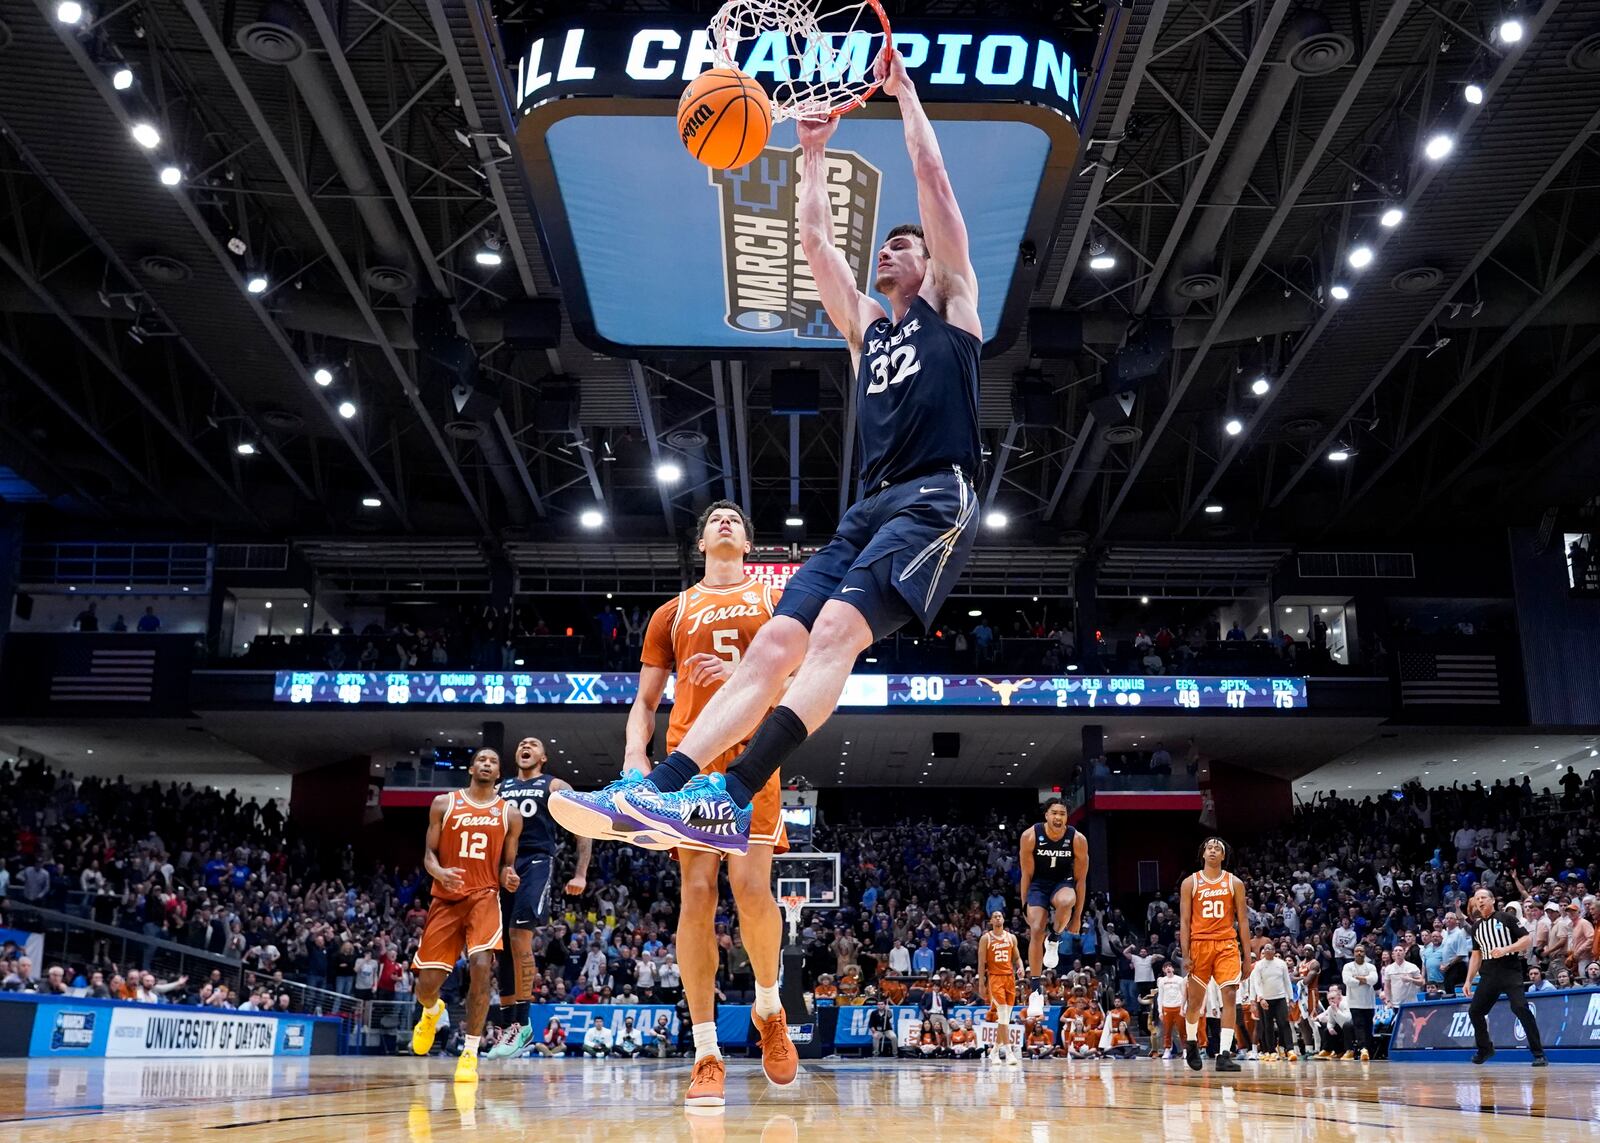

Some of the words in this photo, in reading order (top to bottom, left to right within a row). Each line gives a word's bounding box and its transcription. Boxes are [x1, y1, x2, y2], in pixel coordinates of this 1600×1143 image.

[517, 28, 596, 109] LL
[626, 29, 1080, 118] CHAMPION
[733, 213, 788, 312] MARCH
[866, 344, 921, 396] 32
[743, 565, 774, 575] THE
[688, 604, 761, 635] Texas
[712, 629, 741, 664] 5
[440, 674, 476, 686] BONUS
[565, 674, 601, 703] X
[911, 677, 943, 700] 80
[1110, 679, 1144, 690] BONUS
[1221, 680, 1249, 690] 3PT%
[1272, 680, 1294, 690] FT%
[485, 686, 505, 704] 10
[515, 686, 526, 704] 2
[1057, 690, 1067, 707] 2
[1087, 690, 1097, 707] 7
[1179, 690, 1199, 707] 49
[1227, 690, 1246, 707] 47
[1274, 690, 1293, 707] 75
[501, 789, 544, 798] XAVIER
[452, 813, 500, 830] Texas
[459, 831, 488, 860] 12
[1037, 849, 1072, 857] XAVIER
[1050, 856, 1057, 868] 1
[1198, 888, 1229, 901] Texas
[1202, 900, 1225, 919] 20
[995, 950, 1009, 962] 25
[145, 1017, 219, 1049] UNIVERSITY
[219, 1021, 234, 1049] OF
[235, 1023, 273, 1049] DAYTON
[1448, 1012, 1477, 1037] TEXA
[982, 1027, 1020, 1045] DEFSE
